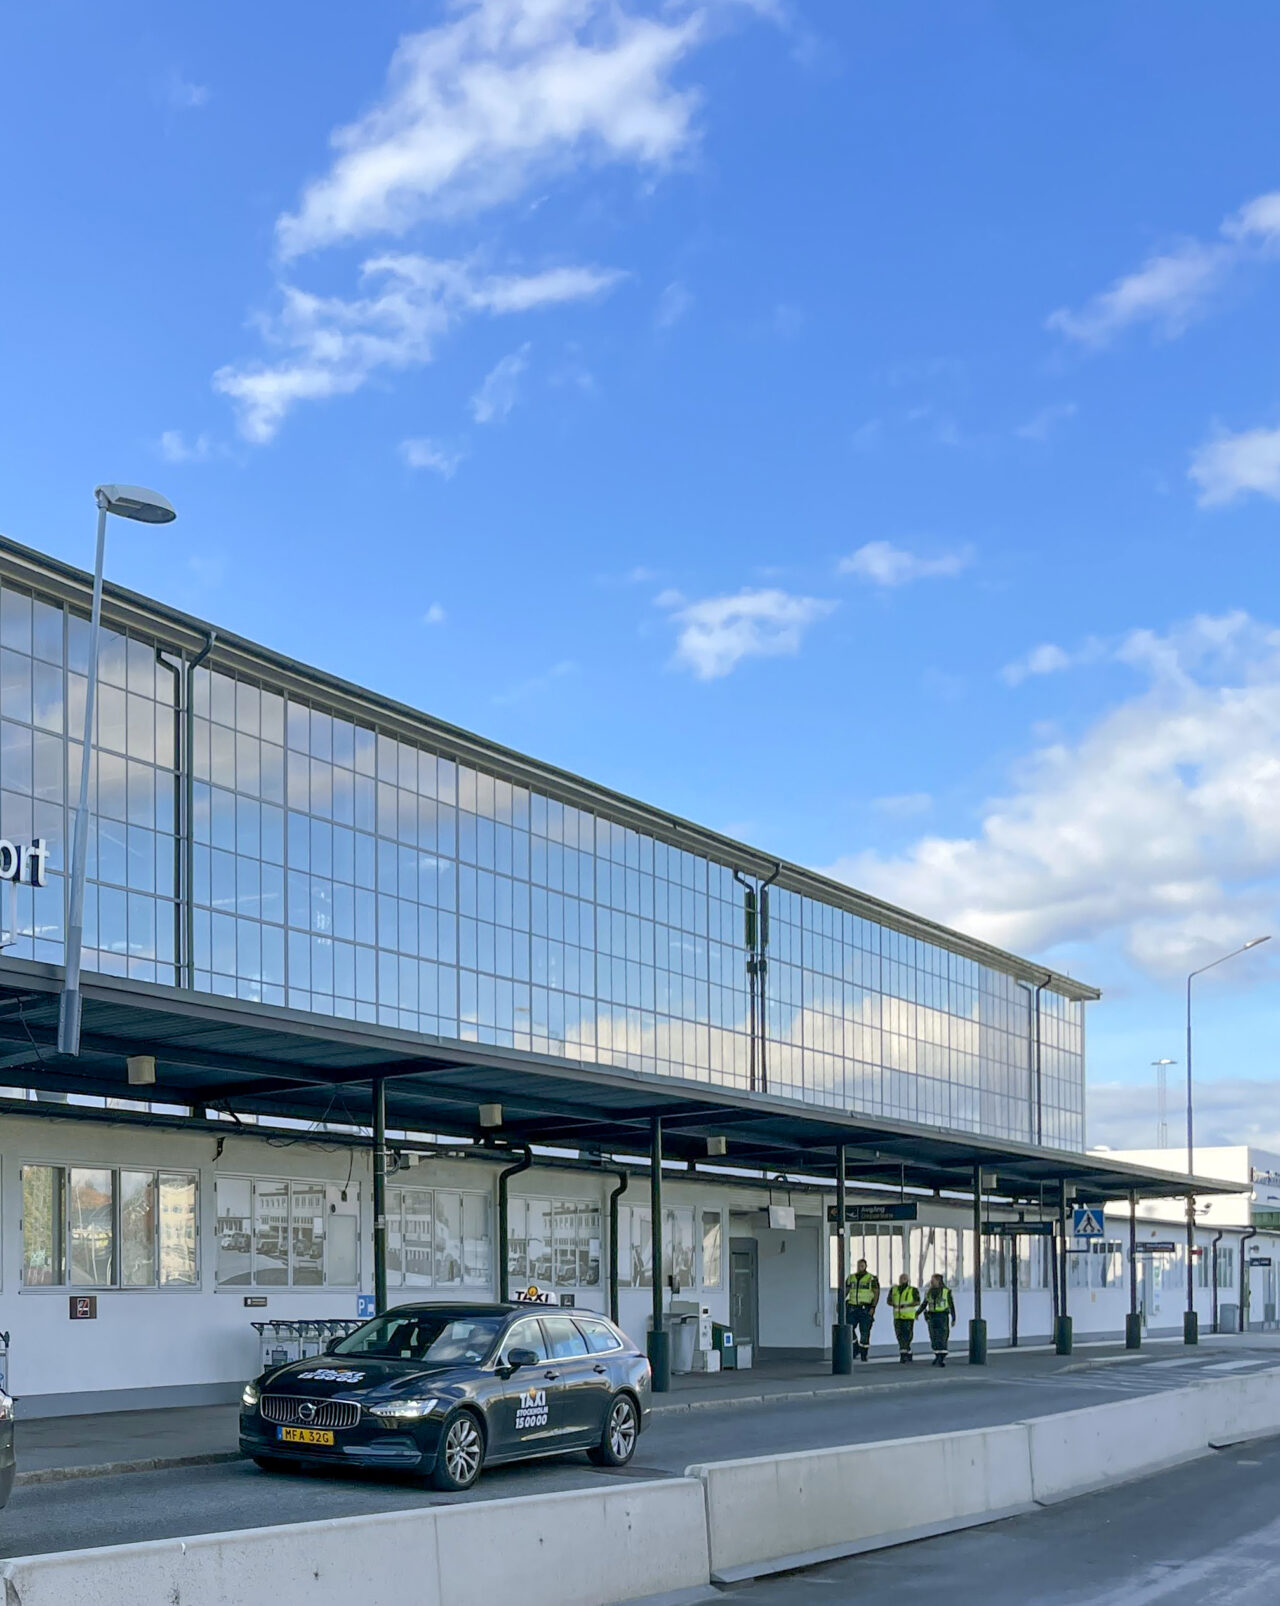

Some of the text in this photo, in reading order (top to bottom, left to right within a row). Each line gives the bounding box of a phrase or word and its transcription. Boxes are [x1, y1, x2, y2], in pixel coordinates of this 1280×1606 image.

[515, 1291, 549, 1302] TAXI
[358, 1299, 365, 1314] P
[520, 1391, 546, 1408] TAXI
[285, 1430, 329, 1442] MFA 32G
